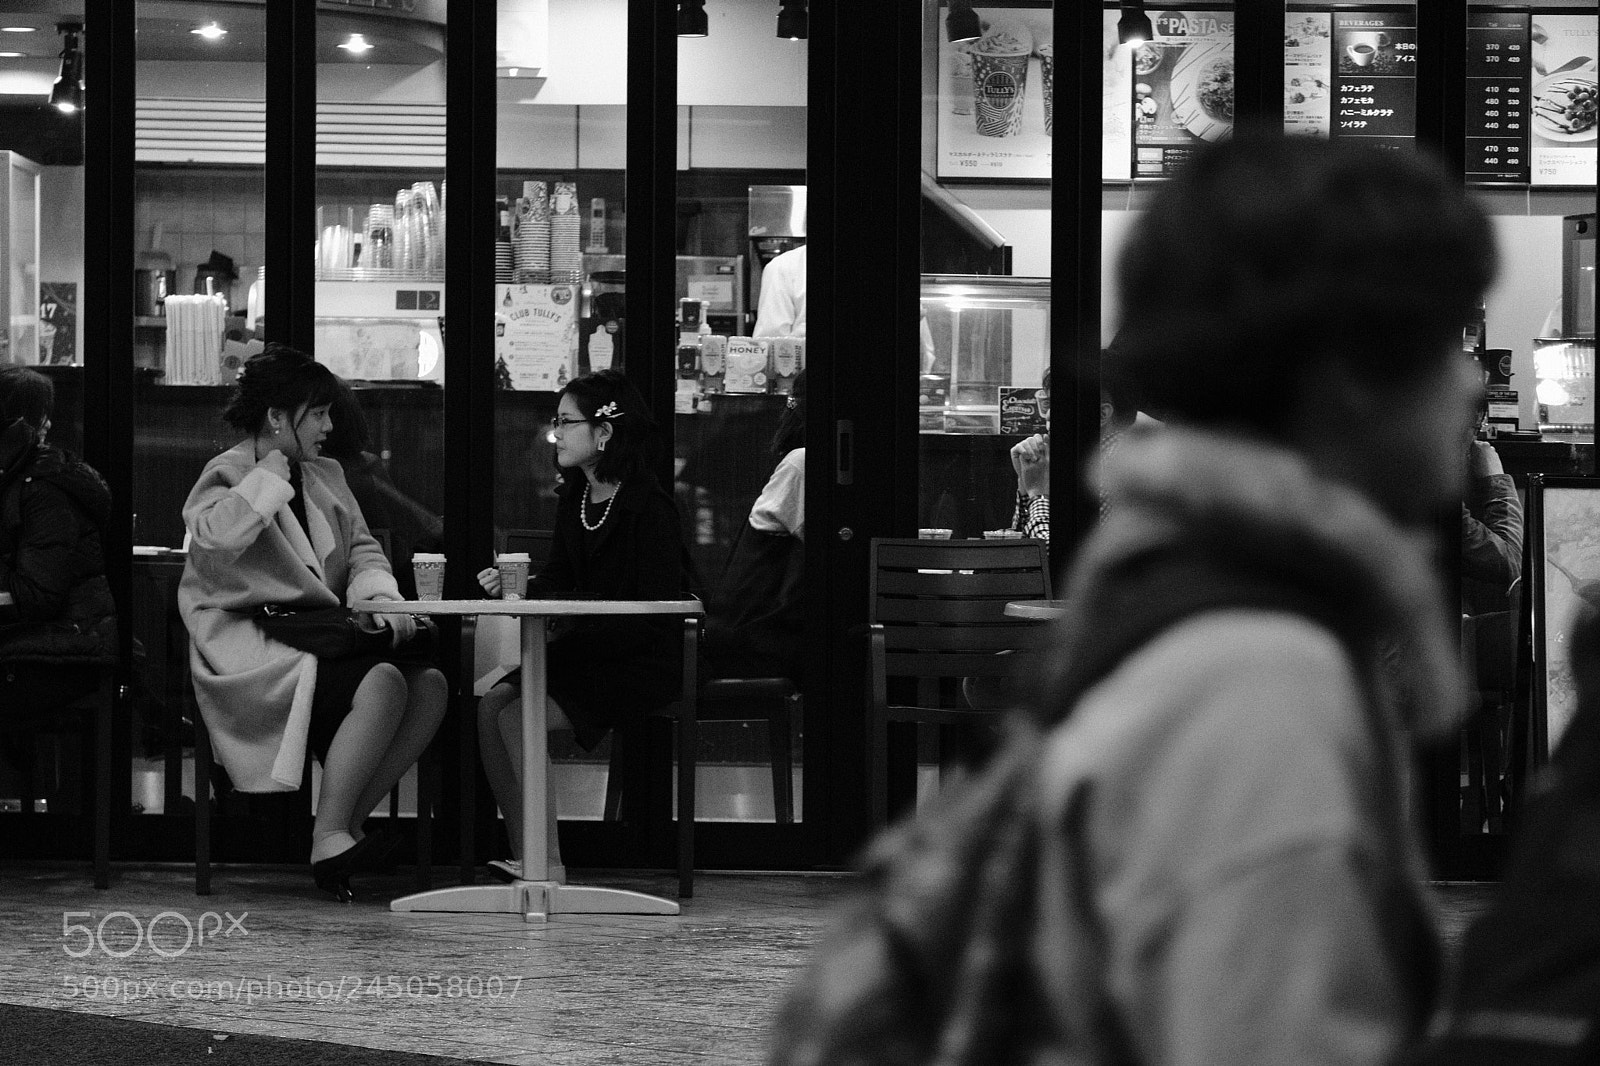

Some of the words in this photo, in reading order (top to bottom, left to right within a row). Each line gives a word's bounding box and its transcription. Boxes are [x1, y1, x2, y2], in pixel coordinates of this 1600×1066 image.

[1168, 18, 1218, 34] PASTA
[1339, 20, 1384, 28] BEVERAGES
[1485, 43, 1500, 51] 370
[1485, 55, 1500, 63] 370
[1340, 84, 1374, 92] カフェラテ
[1484, 145, 1499, 153] 470
[1484, 157, 1499, 165] 440
[40, 303, 58, 319] 17
[509, 308, 530, 321] CLUB
[533, 308, 562, 323] TULLY'S
[729, 346, 767, 354] HONEY
